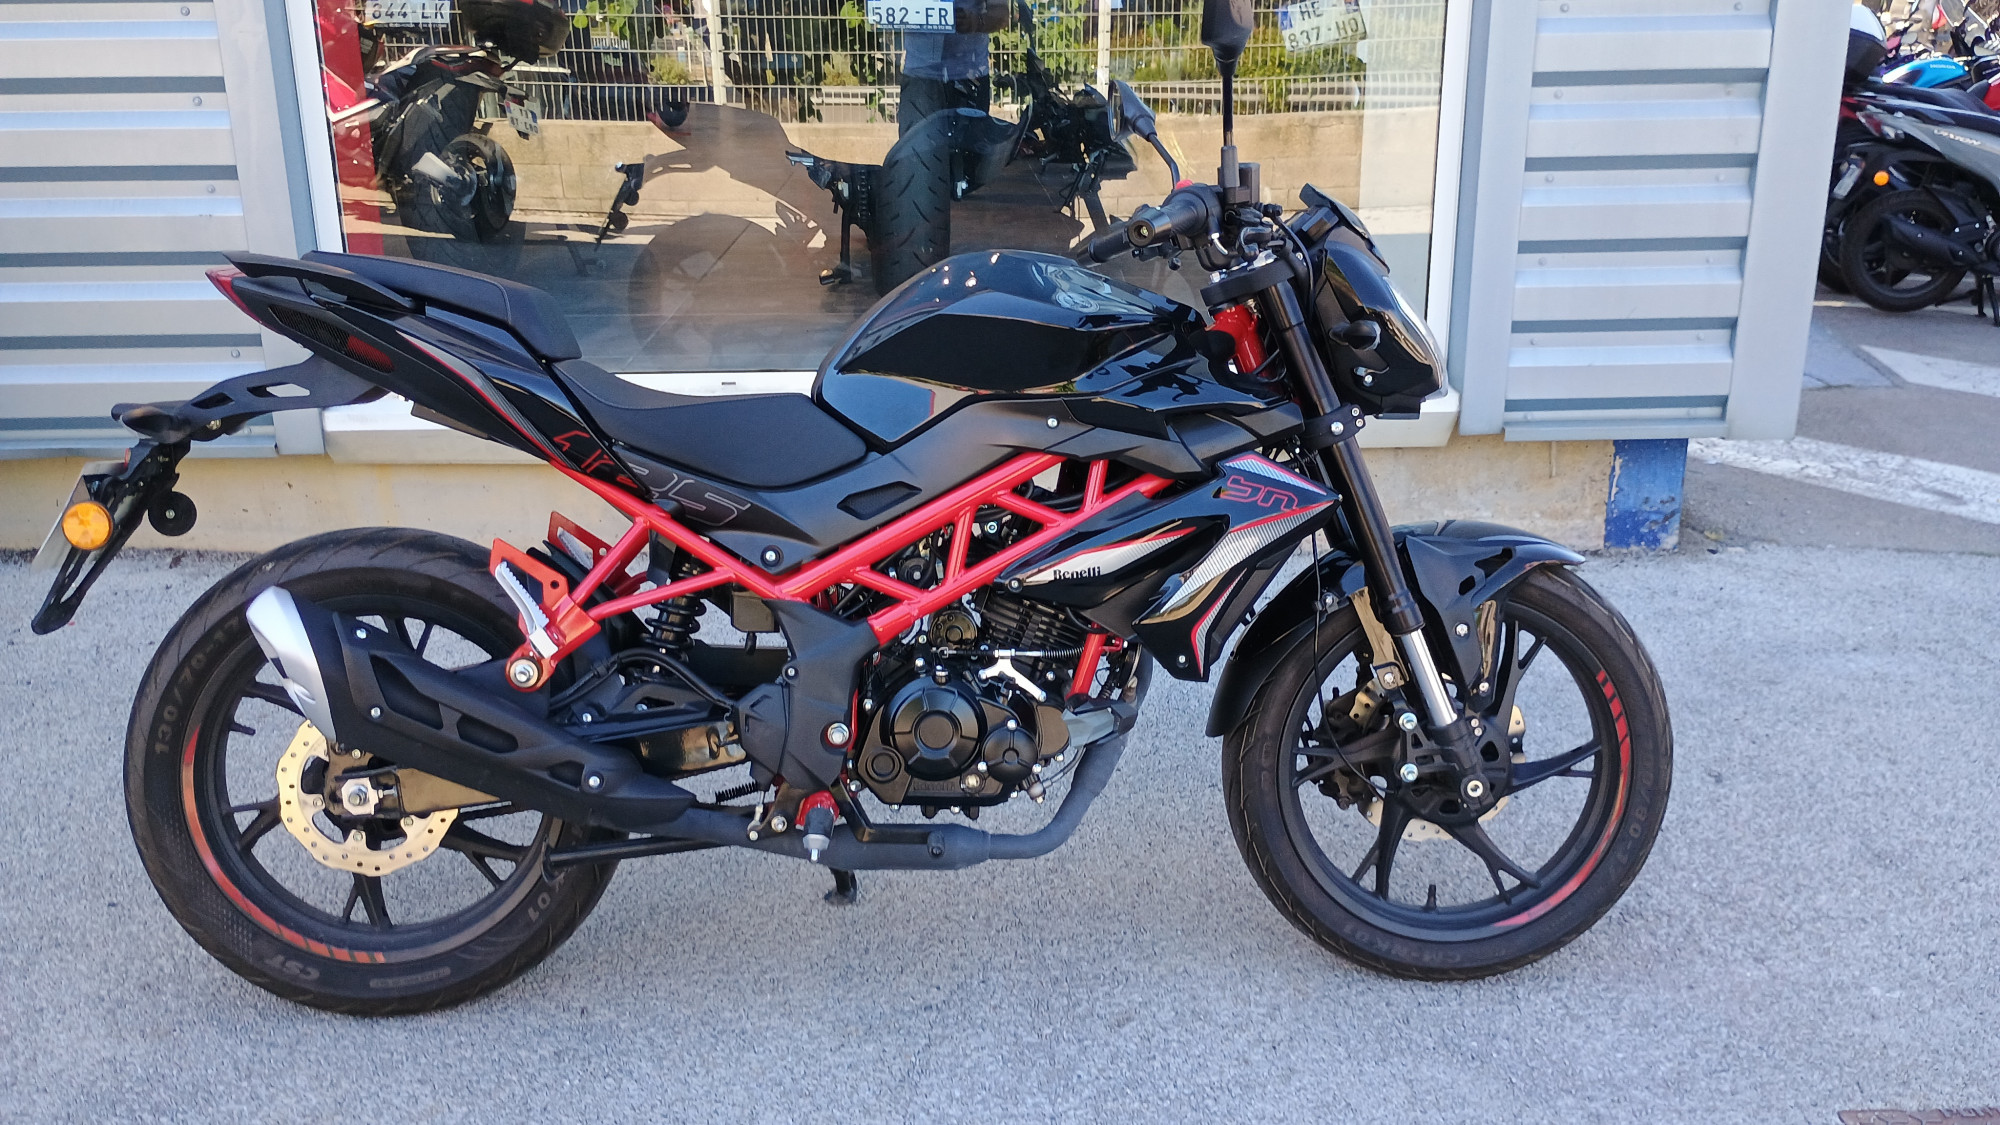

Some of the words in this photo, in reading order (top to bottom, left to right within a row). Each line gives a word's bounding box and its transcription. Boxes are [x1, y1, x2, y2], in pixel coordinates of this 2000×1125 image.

[372, 2, 444, 20] 844-LK
[872, 6, 949, 25] 582-FR
[1053, 566, 1101, 583] Benelli
[263, 953, 321, 981] CST
